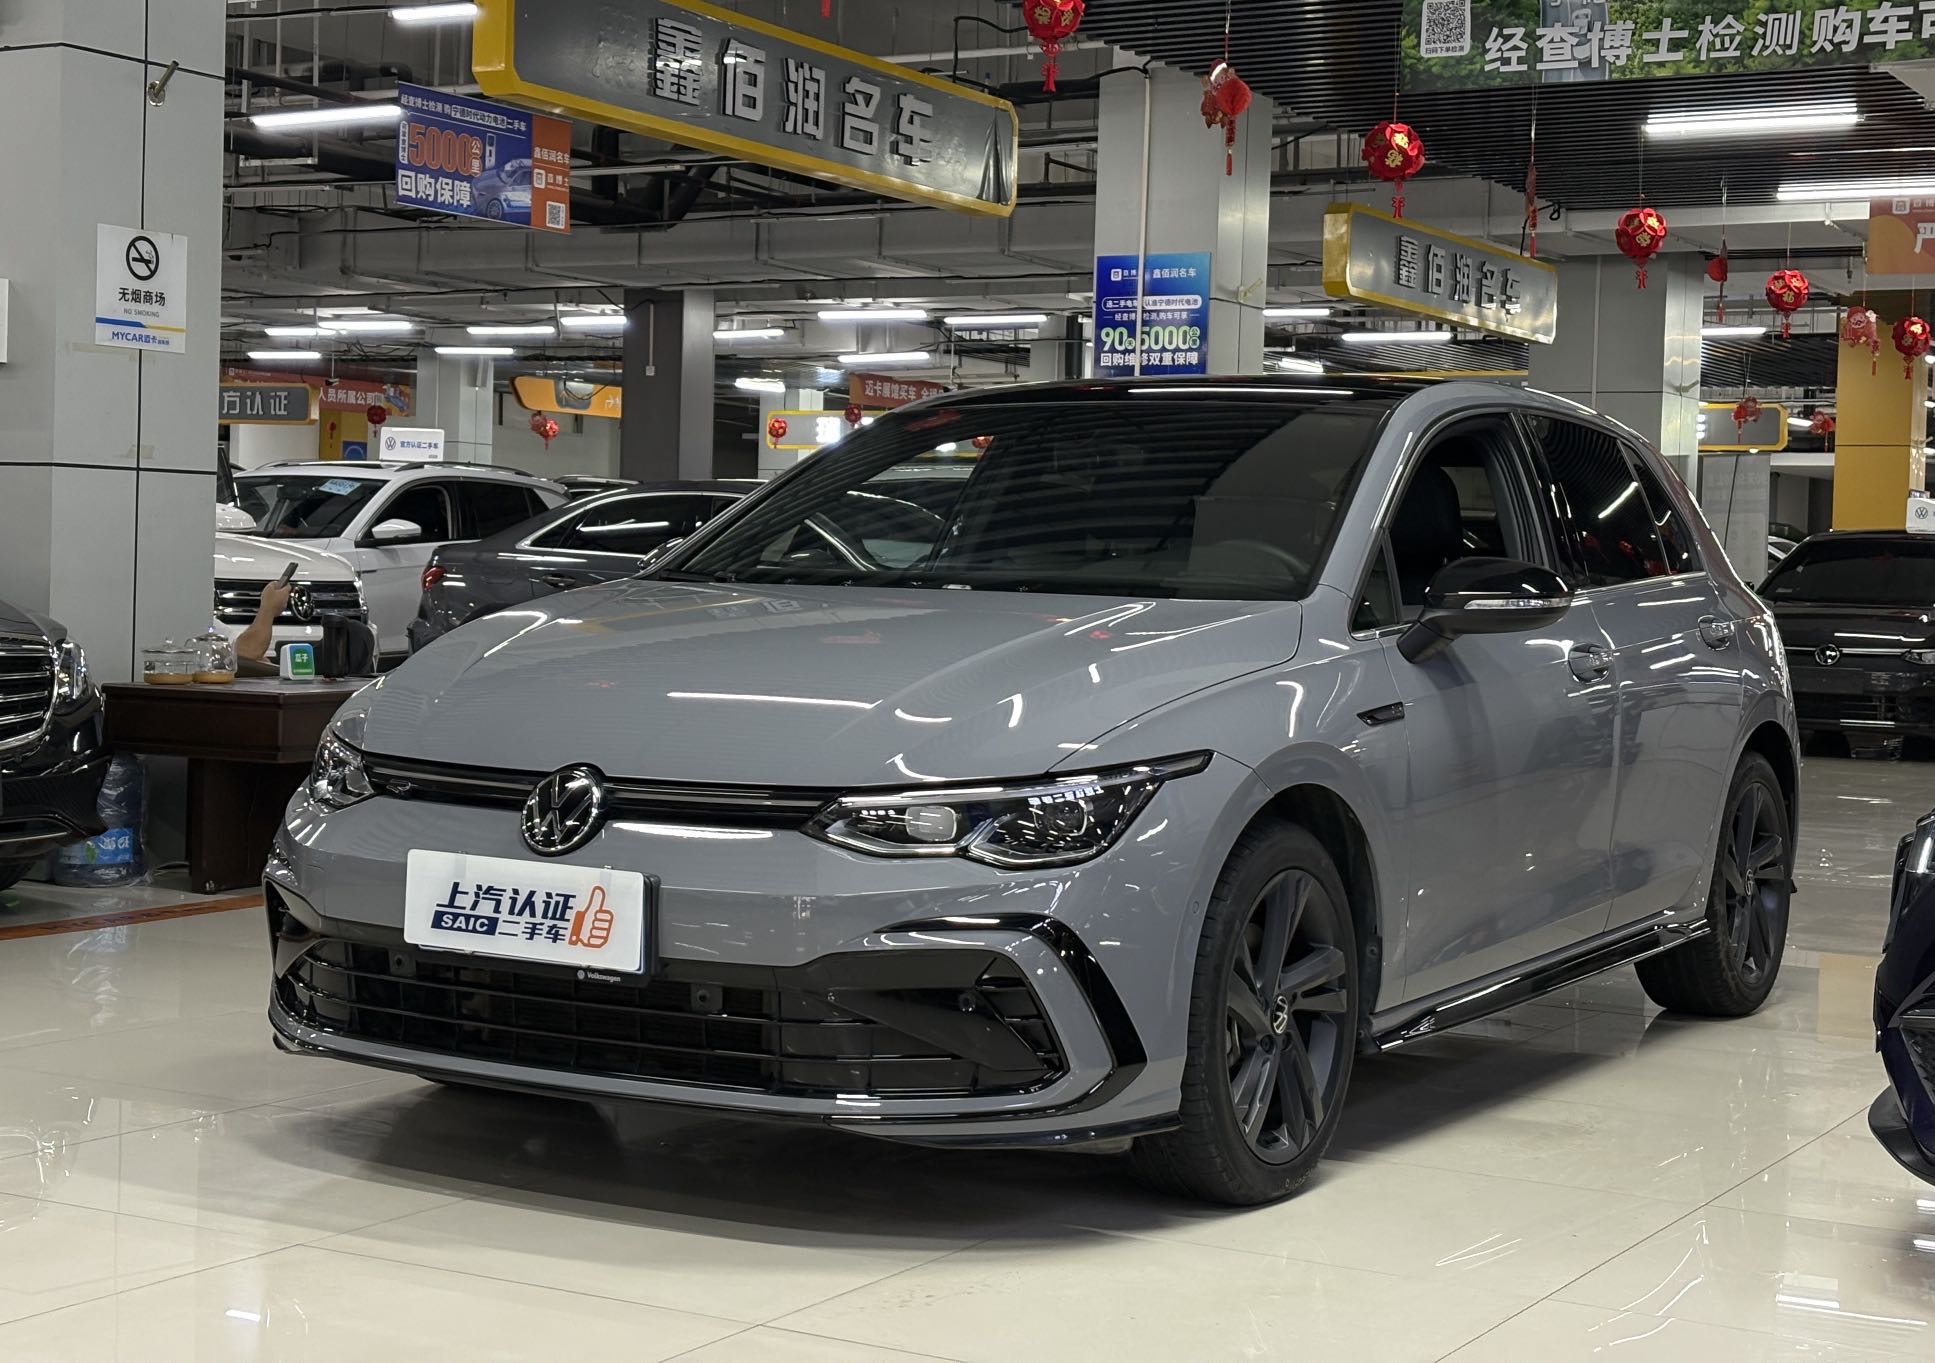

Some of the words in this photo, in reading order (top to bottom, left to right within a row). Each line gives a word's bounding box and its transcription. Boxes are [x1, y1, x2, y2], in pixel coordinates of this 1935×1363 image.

[651, 17, 933, 167] 鑫佰润名车
[533, 146, 571, 165] 鑫佰润名车
[397, 169, 472, 208] 回购保障
[1152, 267, 1197, 279] 鑫佰润名车
[1397, 235, 1520, 315] 鑫佰润名车
[118, 287, 166, 307] 无烟商场
[134, 308, 160, 318] SMOKING
[1100, 351, 1199, 367] 回购维修双重保障
[222, 390, 288, 416] 方认证
[400, 440, 439, 450] 官方认证二手车
[436, 881, 576, 923] 上汽认证
[440, 914, 489, 933] SAIC
[498, 919, 569, 944] 二手车
[586, 970, 621, 983] Volkswagen
